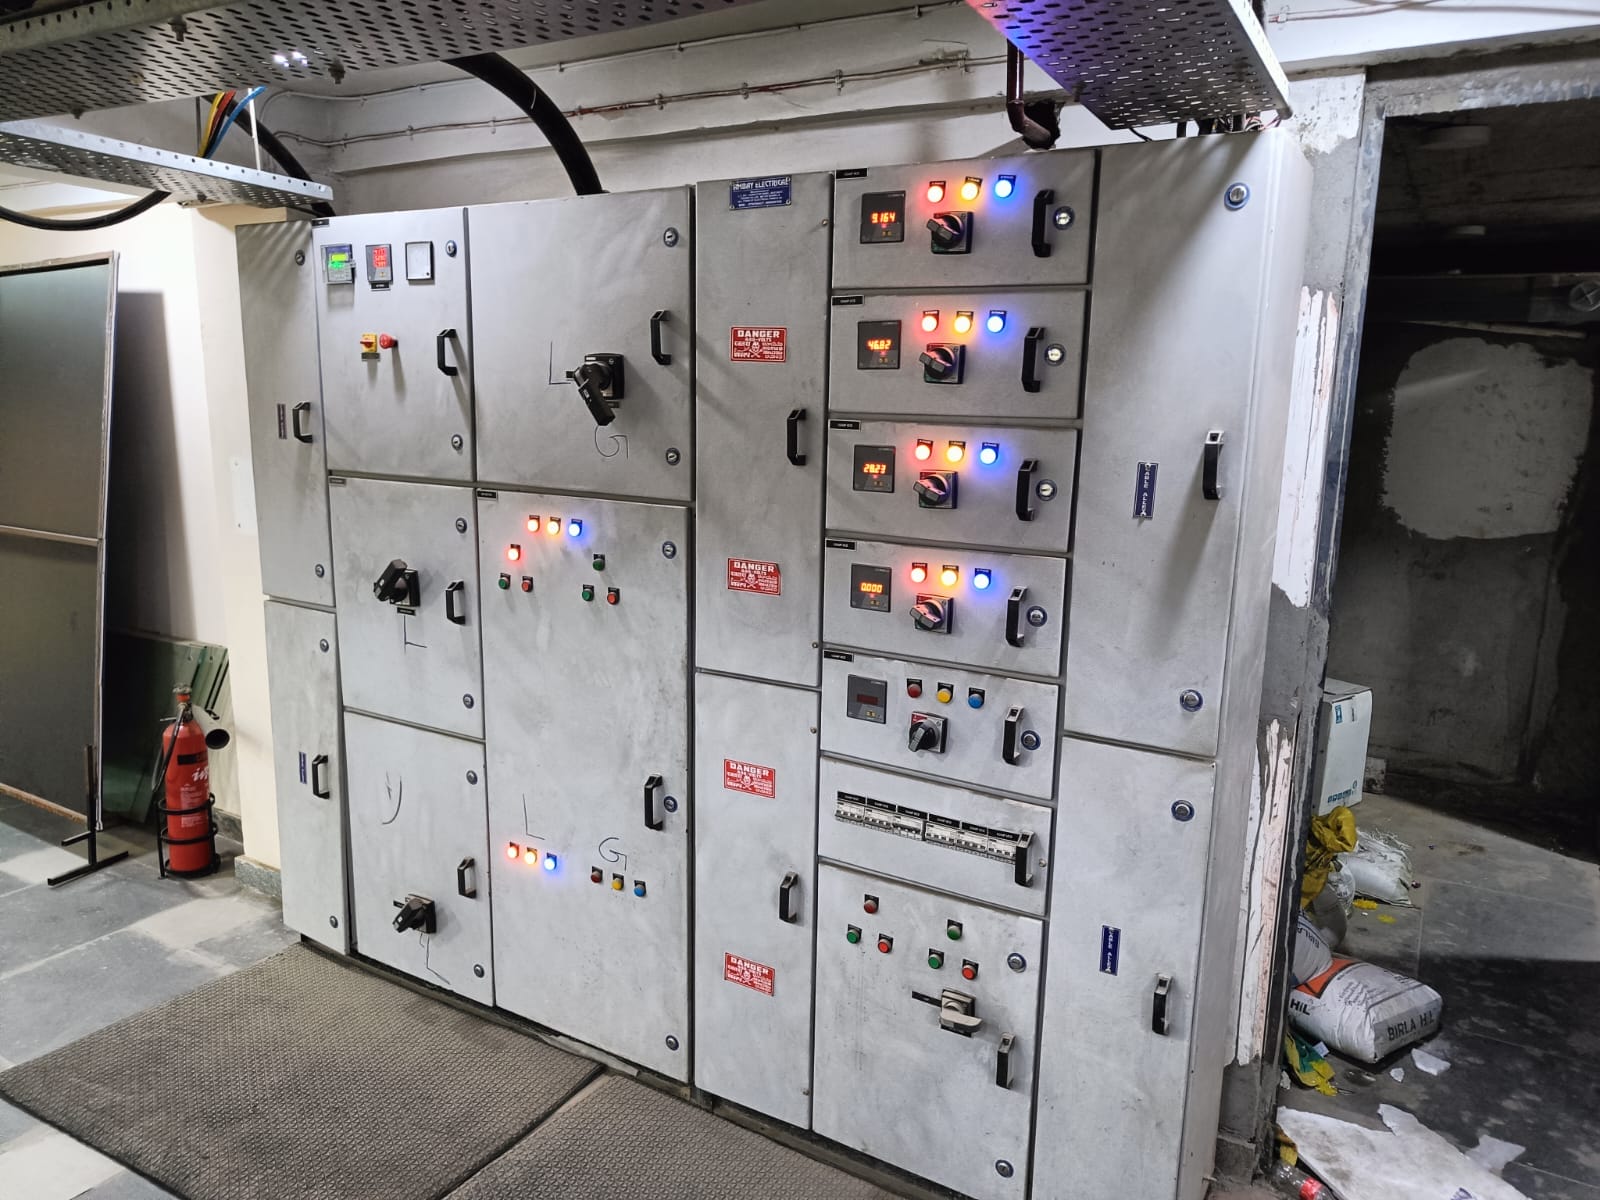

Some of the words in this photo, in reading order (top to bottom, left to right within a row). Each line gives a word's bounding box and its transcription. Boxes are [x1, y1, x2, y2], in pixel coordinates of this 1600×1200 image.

[737, 330, 780, 338] DANGER
[733, 561, 775, 573] DANGER
[730, 762, 770, 777] DANGER
[730, 956, 770, 975] DANGER
[1289, 998, 1311, 1016] HIL
[1387, 1017, 1417, 1041] BIRLA
